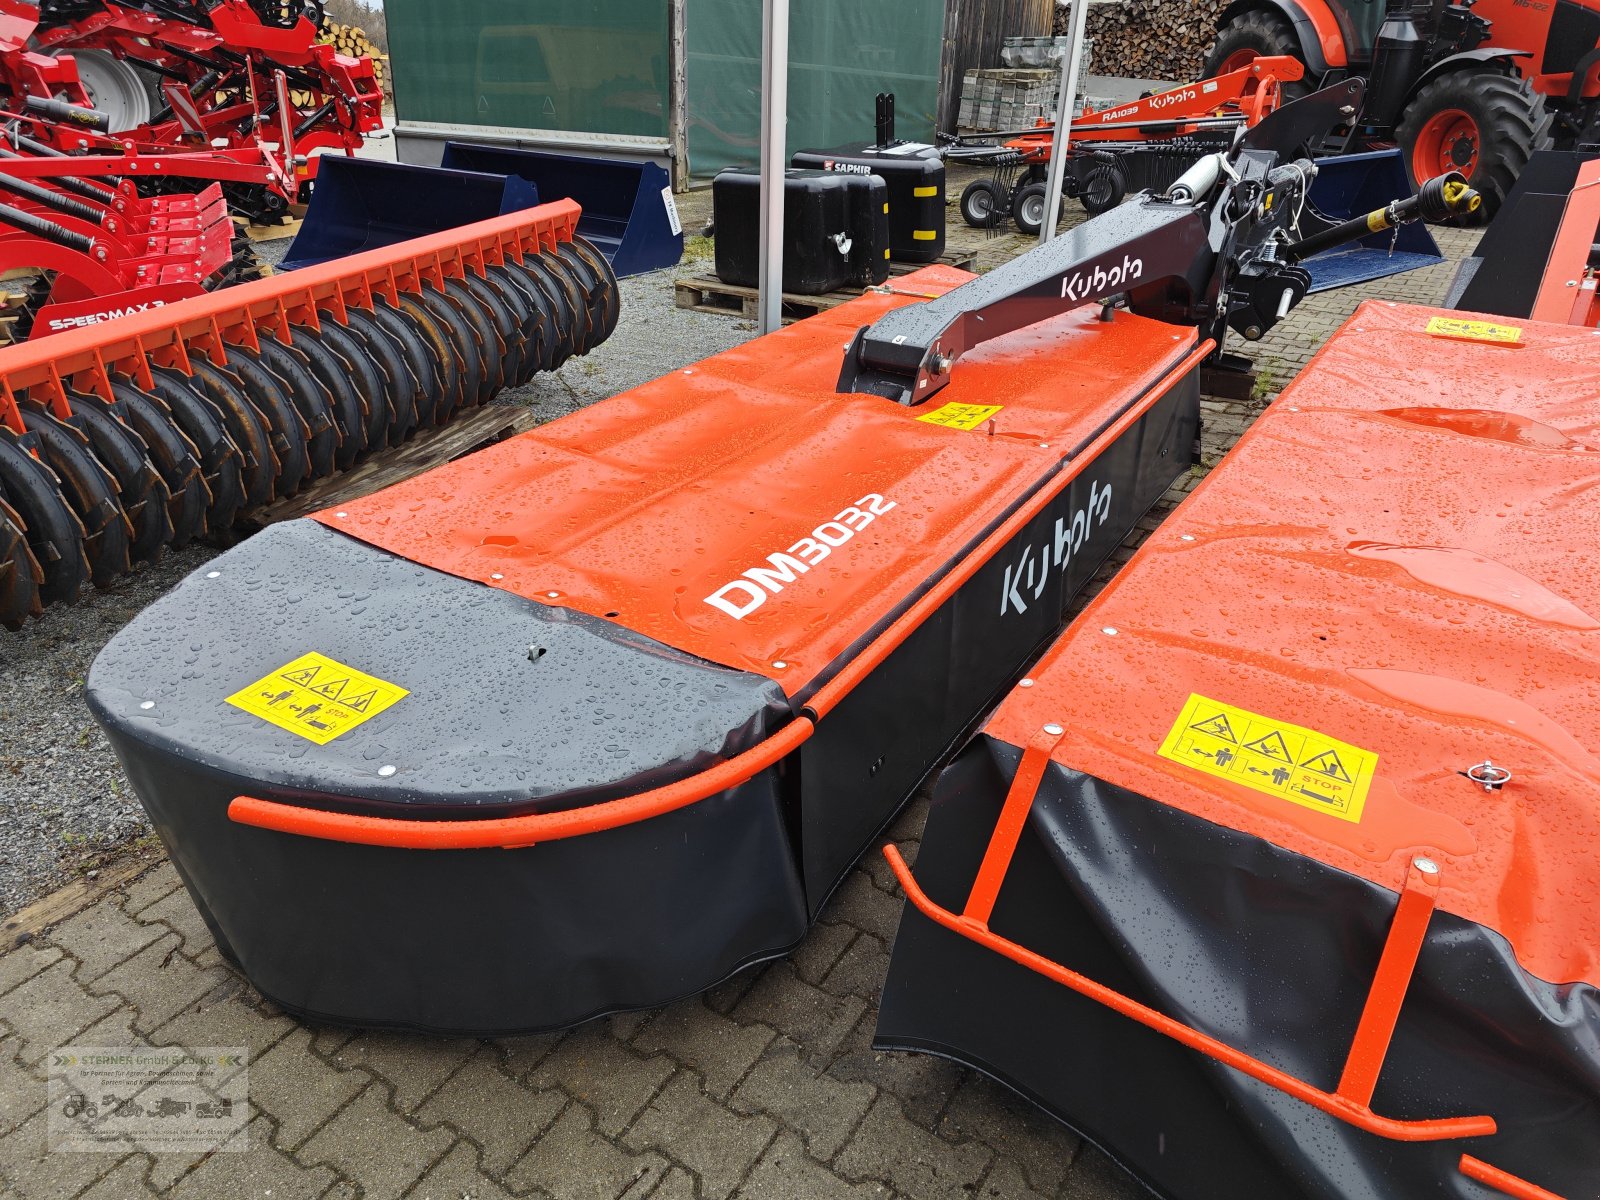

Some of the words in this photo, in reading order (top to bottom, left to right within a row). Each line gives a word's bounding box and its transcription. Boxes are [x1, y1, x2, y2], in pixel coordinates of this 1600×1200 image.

[1149, 89, 1196, 109] Kubota
[1102, 106, 1139, 122] RA1039
[834, 163, 871, 175] SAPHIR
[1060, 255, 1143, 302] Kubota
[49, 302, 149, 330] SPEEDMAX
[703, 493, 897, 620] DM3032
[1000, 480, 1112, 617] Kubota
[325, 708, 349, 719] STOP
[1302, 775, 1342, 791] STOP
